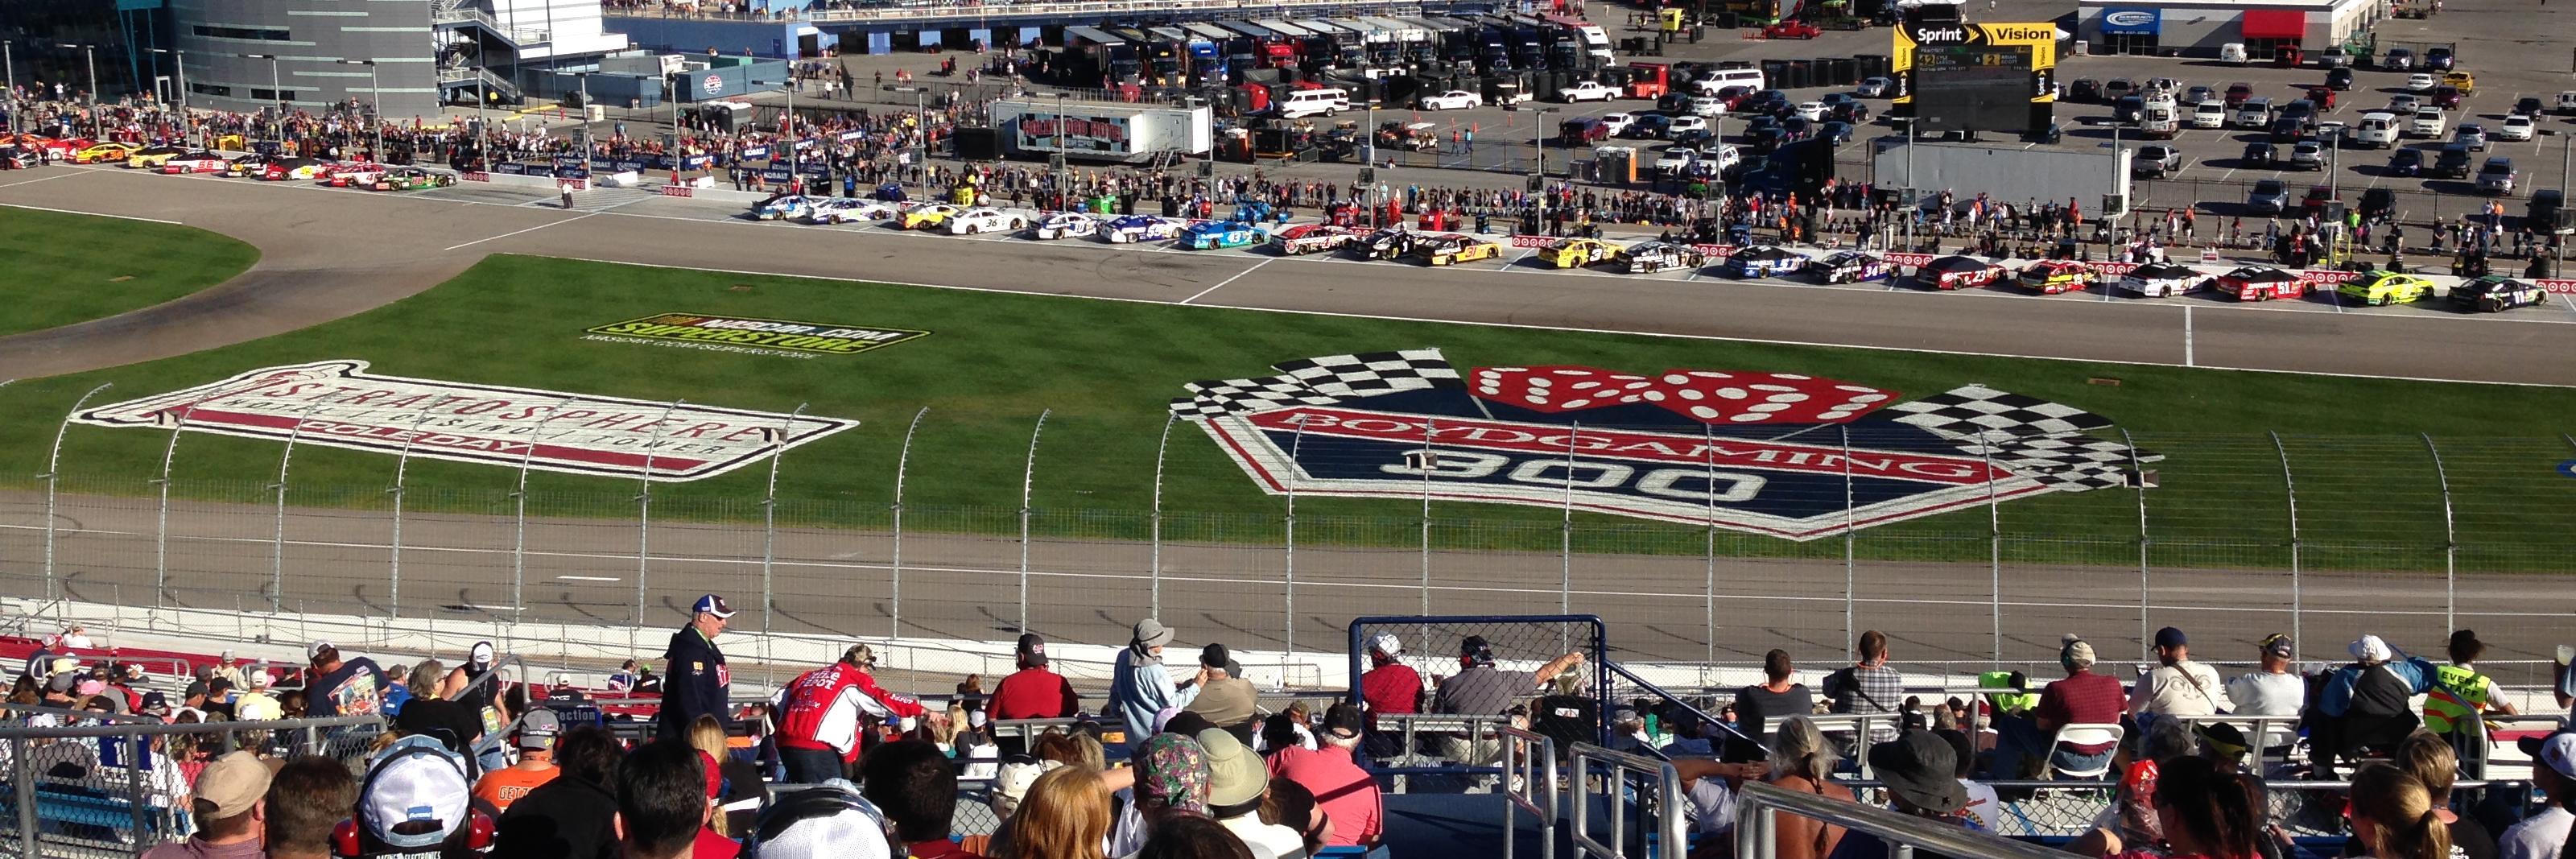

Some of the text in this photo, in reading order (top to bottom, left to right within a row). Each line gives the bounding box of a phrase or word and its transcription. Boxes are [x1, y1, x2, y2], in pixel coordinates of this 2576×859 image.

[1918, 27, 2051, 44] Sprint Vision
[1919, 54, 1935, 65] 42
[1091, 121, 1124, 142] HOTEL
[745, 147, 766, 156] KOBALT
[763, 171, 788, 180] KOBALT
[986, 218, 997, 228] 36
[1228, 230, 1241, 243] 43
[1320, 237, 1331, 249] 4
[1465, 245, 1477, 258] 31
[1589, 248, 1603, 262] 3
[1665, 254, 1679, 267] 48
[1864, 266, 1878, 278] 34
[1974, 270, 1986, 282] 23
[2073, 273, 2083, 285] 15
[2277, 281, 2290, 295] 51
[2512, 291, 2525, 304] 11
[606, 322, 881, 351] SUPERSTORE
[694, 319, 902, 341] NASCAR.COM
[263, 382, 765, 442] STRATOSPHERE
[225, 399, 726, 454] HOTEL CASINO TOWER
[1379, 448, 1768, 502] 300
[2441, 671, 2480, 688] EVENT
